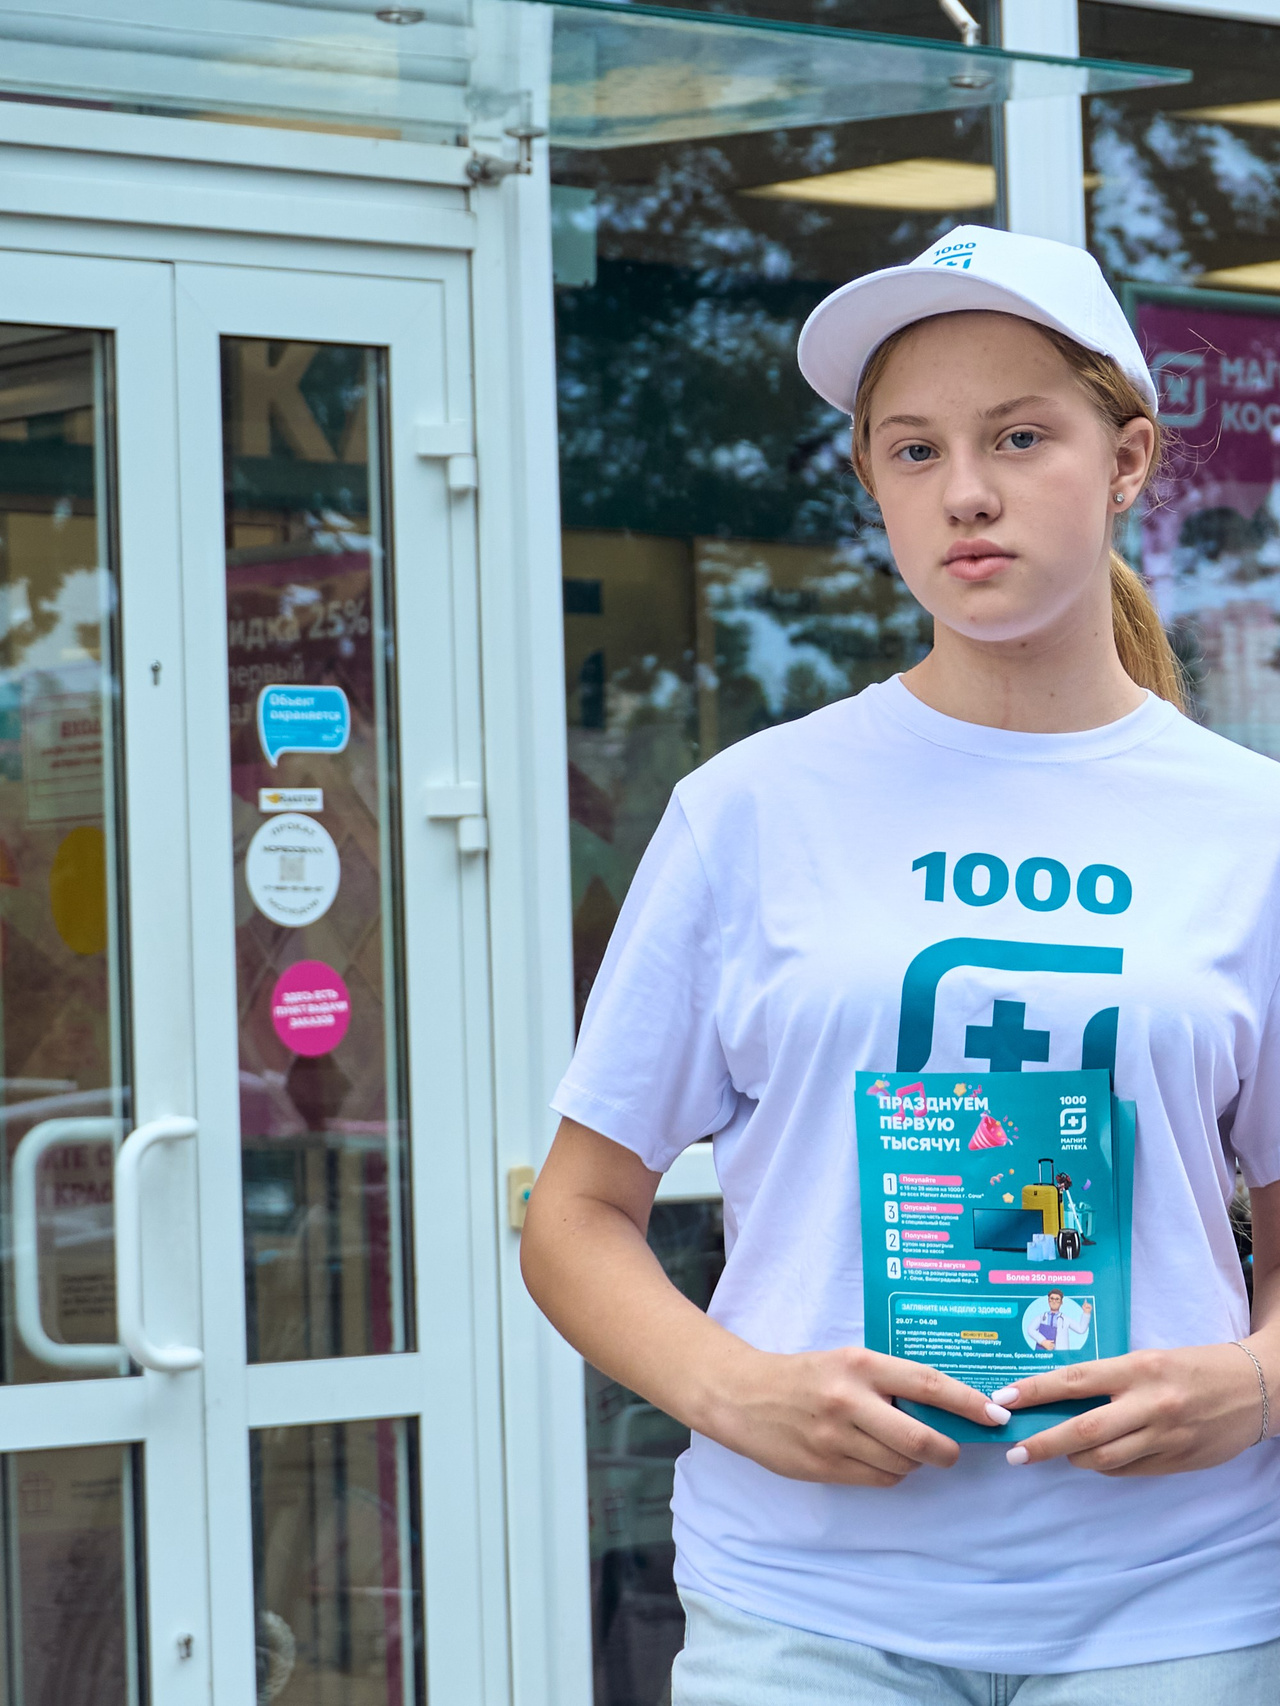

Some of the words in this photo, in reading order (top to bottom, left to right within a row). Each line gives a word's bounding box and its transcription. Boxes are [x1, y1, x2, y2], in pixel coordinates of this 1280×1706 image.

[933, 241, 977, 256] 1000
[269, 693, 315, 707] Объект
[270, 710, 342, 722] охраняется
[911, 851, 1133, 916] 1000
[879, 1096, 989, 1113] ПРАЗДНУЕМ
[1060, 1095, 1087, 1105] 1000
[880, 1116, 955, 1132] ПЕРВУЮ
[880, 1135, 961, 1152] ТЫСЯЧУ!
[886, 1177, 893, 1191] 1
[902, 1176, 937, 1185] Покупайте
[888, 1205, 895, 1220] 3
[903, 1204, 937, 1212] Опускайте
[889, 1233, 897, 1248] 2
[904, 1232, 938, 1240] Получайте
[890, 1261, 897, 1275] 4
[905, 1260, 938, 1268] Приходите
[1005, 1273, 1030, 1282] Более
[1031, 1274, 1047, 1282] 250
[1047, 1274, 1076, 1283] призов
[901, 1303, 938, 1312] ЗАГЛЯНИТЕ
[949, 1305, 977, 1314] НЕДЕЛЮ
[977, 1306, 1012, 1314] ЗДОРОВЬЯ
